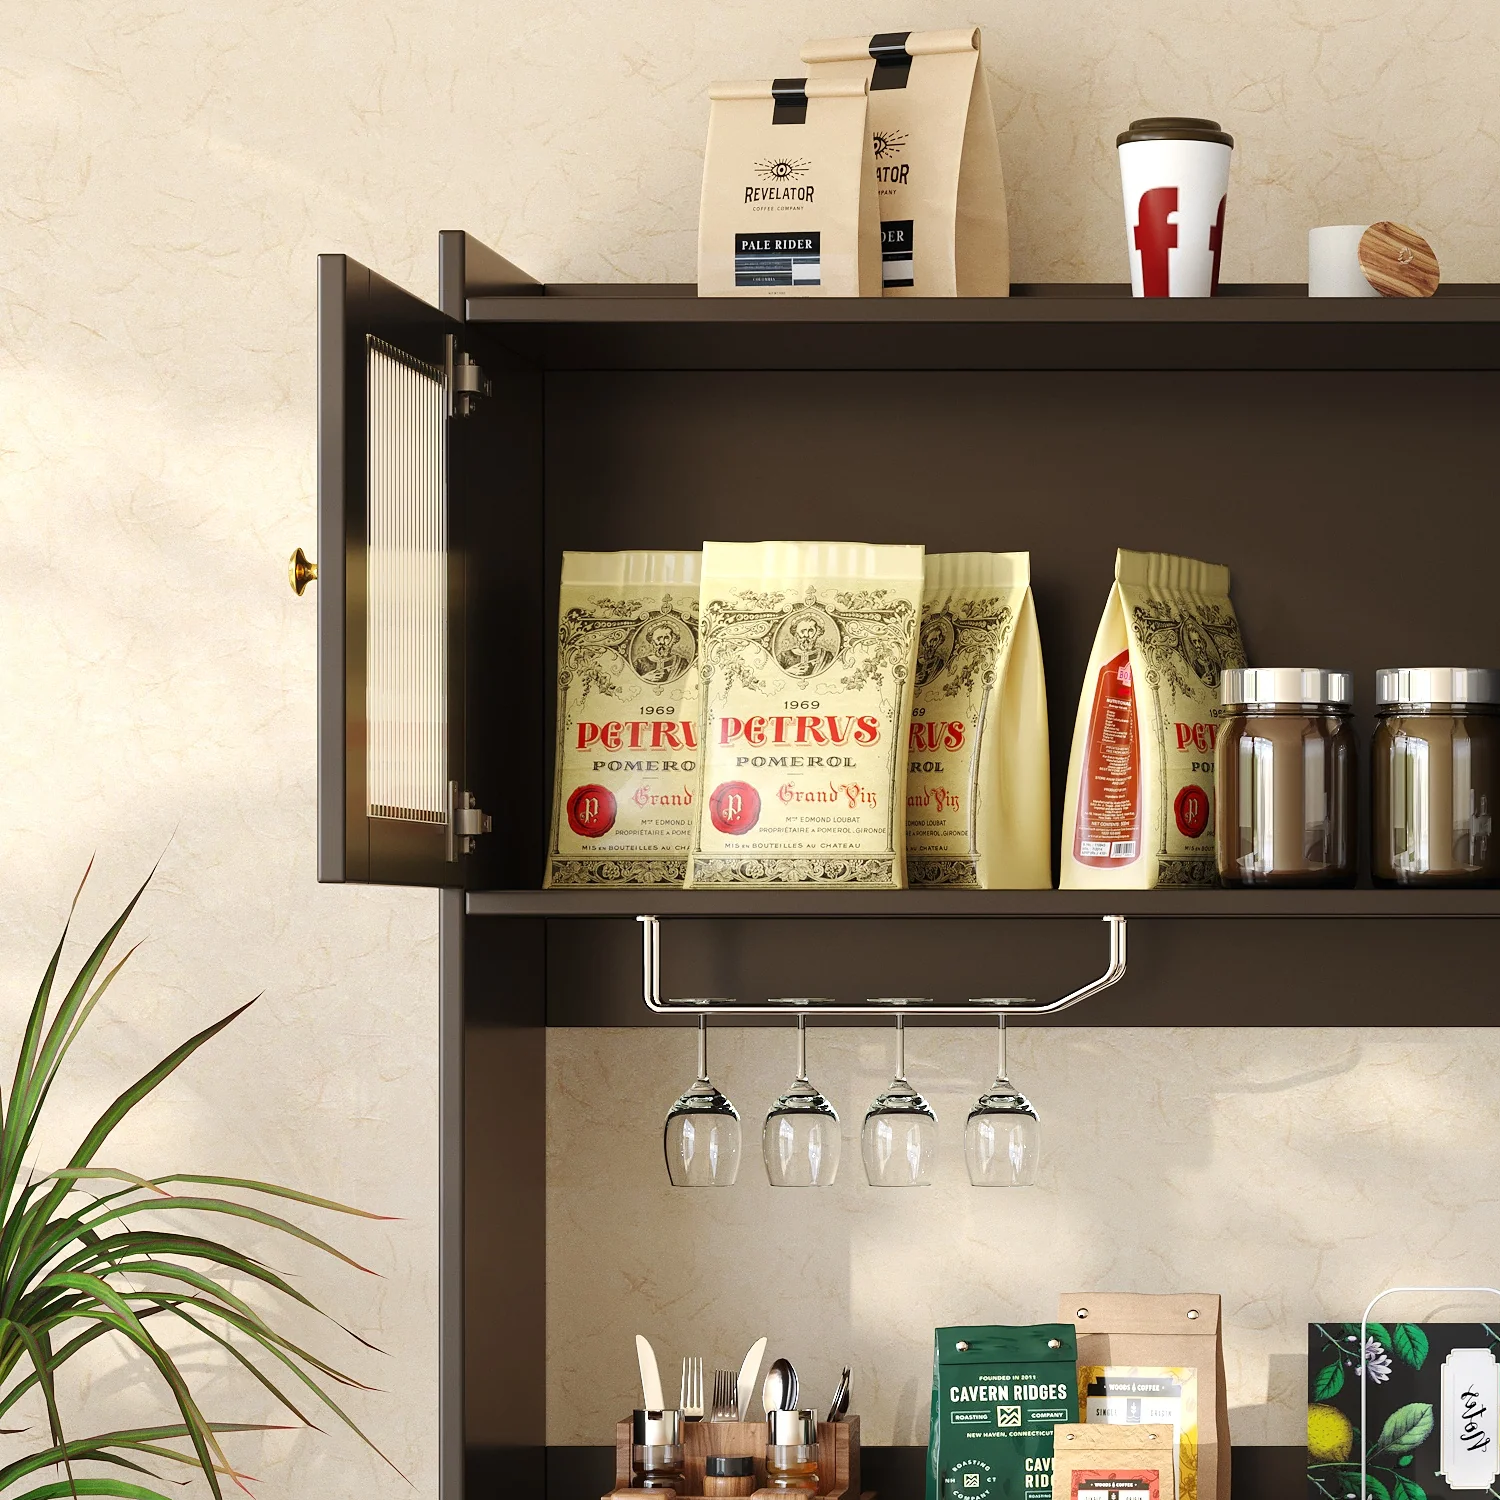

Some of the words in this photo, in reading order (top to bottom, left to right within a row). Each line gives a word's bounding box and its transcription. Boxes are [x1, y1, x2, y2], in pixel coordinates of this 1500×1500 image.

[744, 186, 814, 204] REVELATOR
[881, 230, 904, 242] DER
[742, 240, 771, 250] PALE
[775, 239, 812, 250] RIDER
[640, 706, 675, 715] 1969
[784, 701, 820, 710] 1969
[912, 708, 926, 716] 69
[576, 721, 697, 752] PETRV
[909, 721, 965, 752] RVS
[1174, 722, 1216, 753] PET
[593, 760, 696, 771] POMERO
[736, 756, 856, 767] POMEROL
[632, 785, 692, 808] Grand
[776, 781, 838, 805] Grand
[908, 785, 929, 807] and
[950, 1386, 1009, 1402] CAVERN
[1014, 1384, 1067, 1400] RIDGES
[952, 1460, 990, 1472] ROASTING
[1025, 1458, 1054, 1471] CAV
[1025, 1474, 1053, 1488] RID
